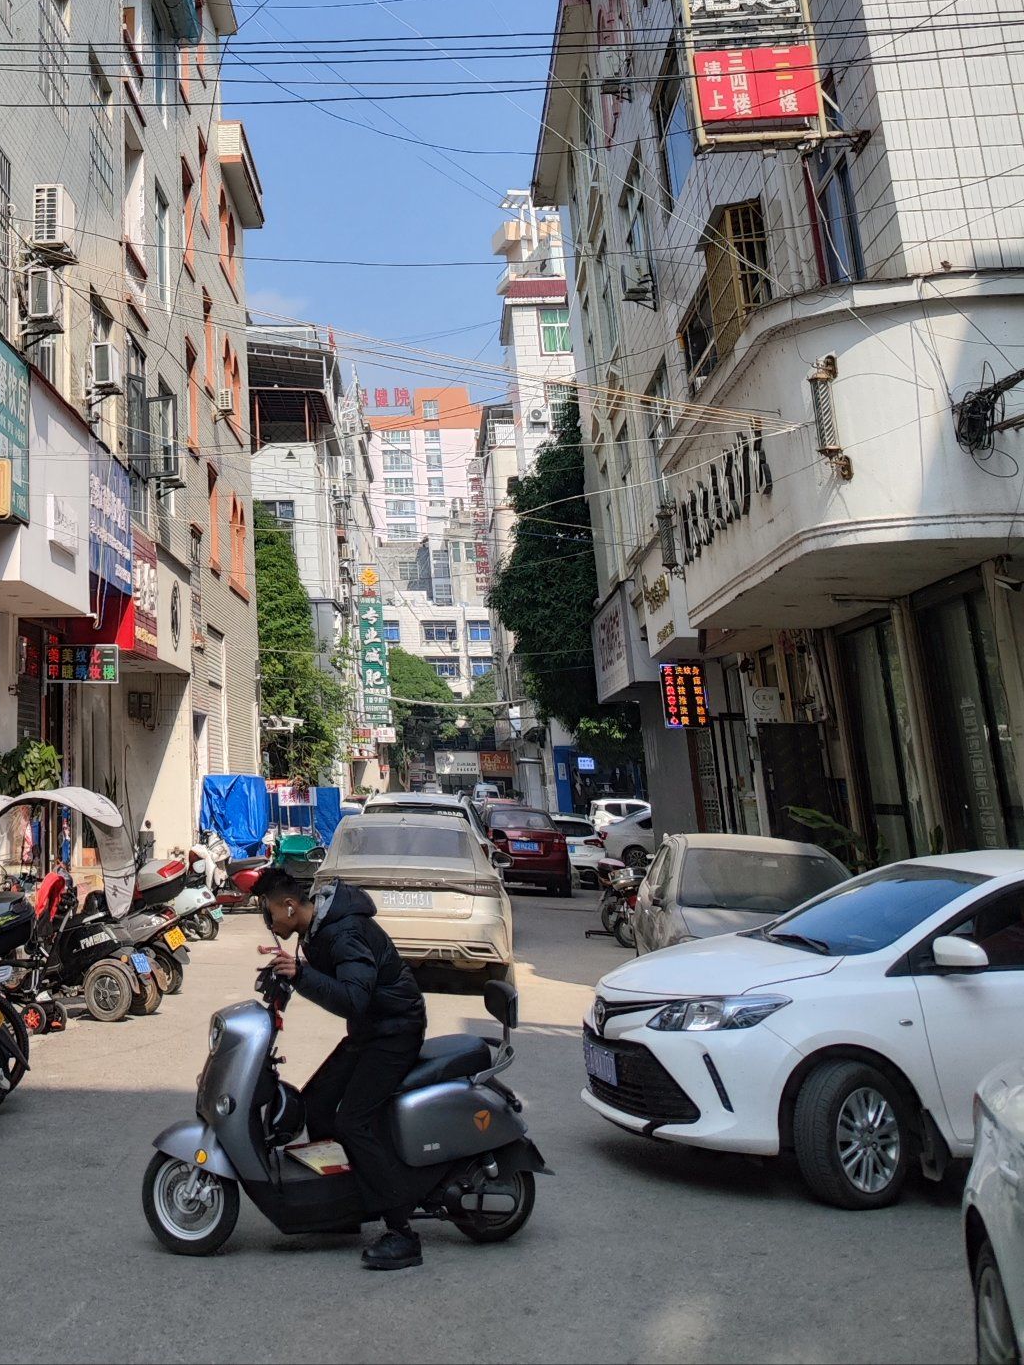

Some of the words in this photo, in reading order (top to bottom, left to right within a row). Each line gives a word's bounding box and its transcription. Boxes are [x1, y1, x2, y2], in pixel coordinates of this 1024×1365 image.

[703, 60, 727, 111] 请上
[727, 51, 752, 116] 三四楼
[102, 649, 116, 680] 二楼
